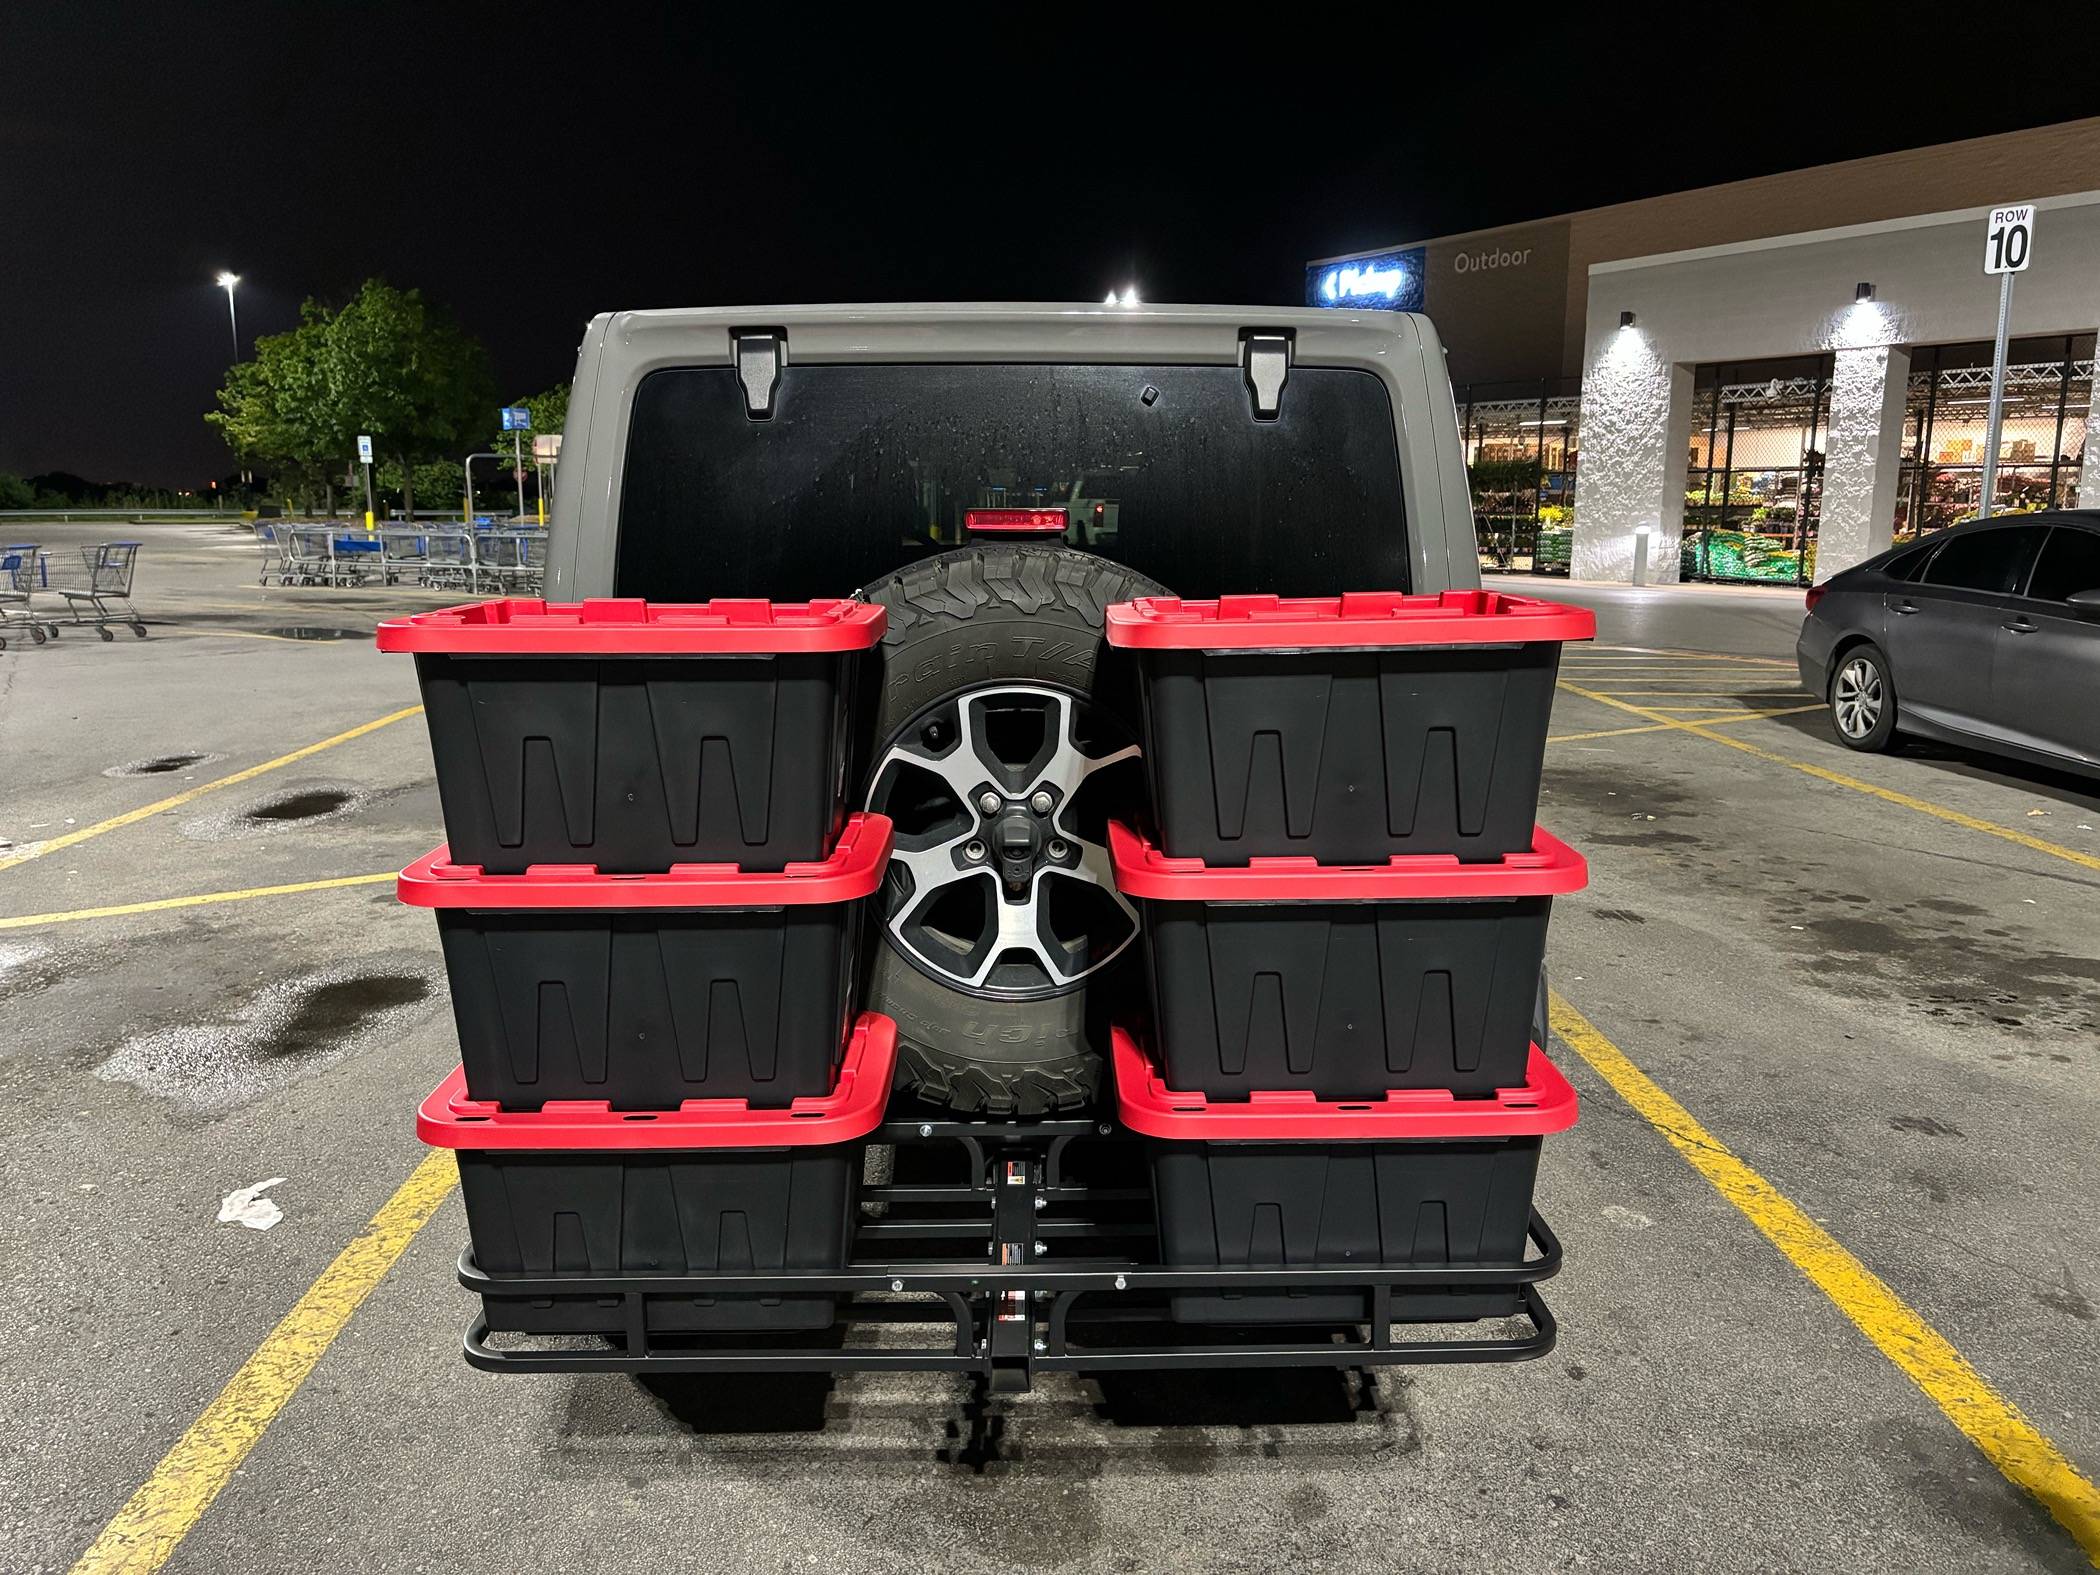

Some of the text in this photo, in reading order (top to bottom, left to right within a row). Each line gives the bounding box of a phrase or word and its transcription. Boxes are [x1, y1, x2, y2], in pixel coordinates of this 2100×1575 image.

[1995, 209, 2028, 224] ROW
[1990, 224, 2028, 269] 10
[1454, 248, 1532, 274] Outdoor
